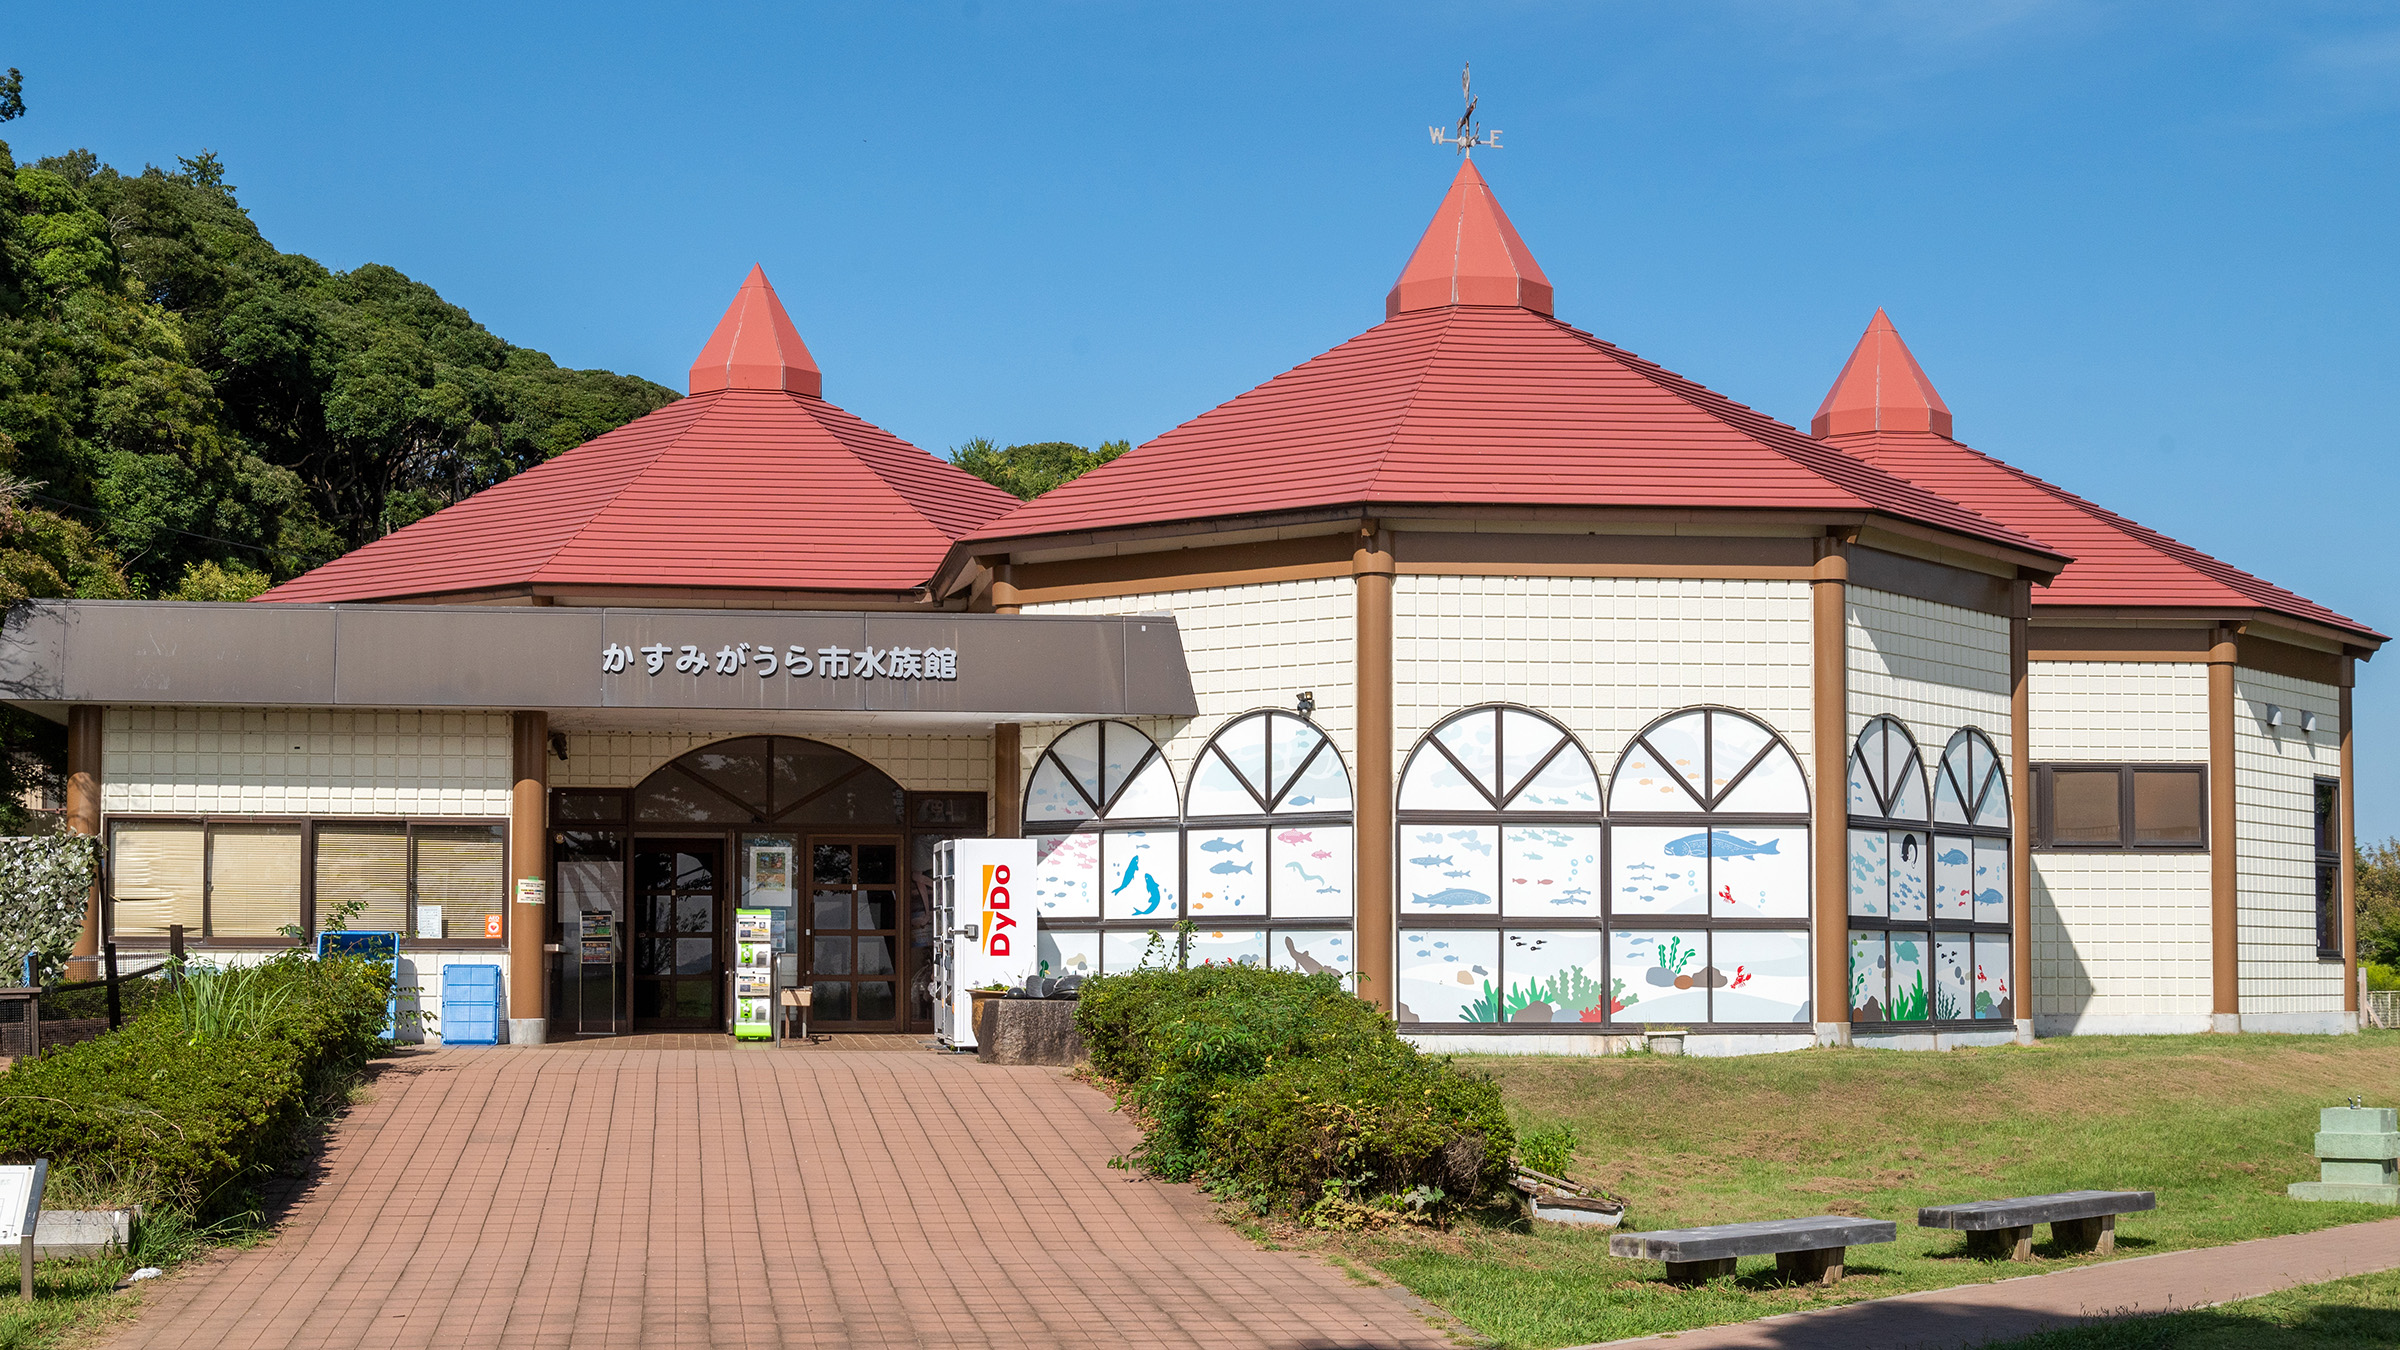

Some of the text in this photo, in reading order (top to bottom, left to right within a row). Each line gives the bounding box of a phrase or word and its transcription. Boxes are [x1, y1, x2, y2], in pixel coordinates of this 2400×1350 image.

[1429, 126, 1445, 145] W
[1490, 130, 1504, 149] E
[602, 642, 957, 680] かすみがうら市水族館
[990, 864, 1017, 957] DyDo
